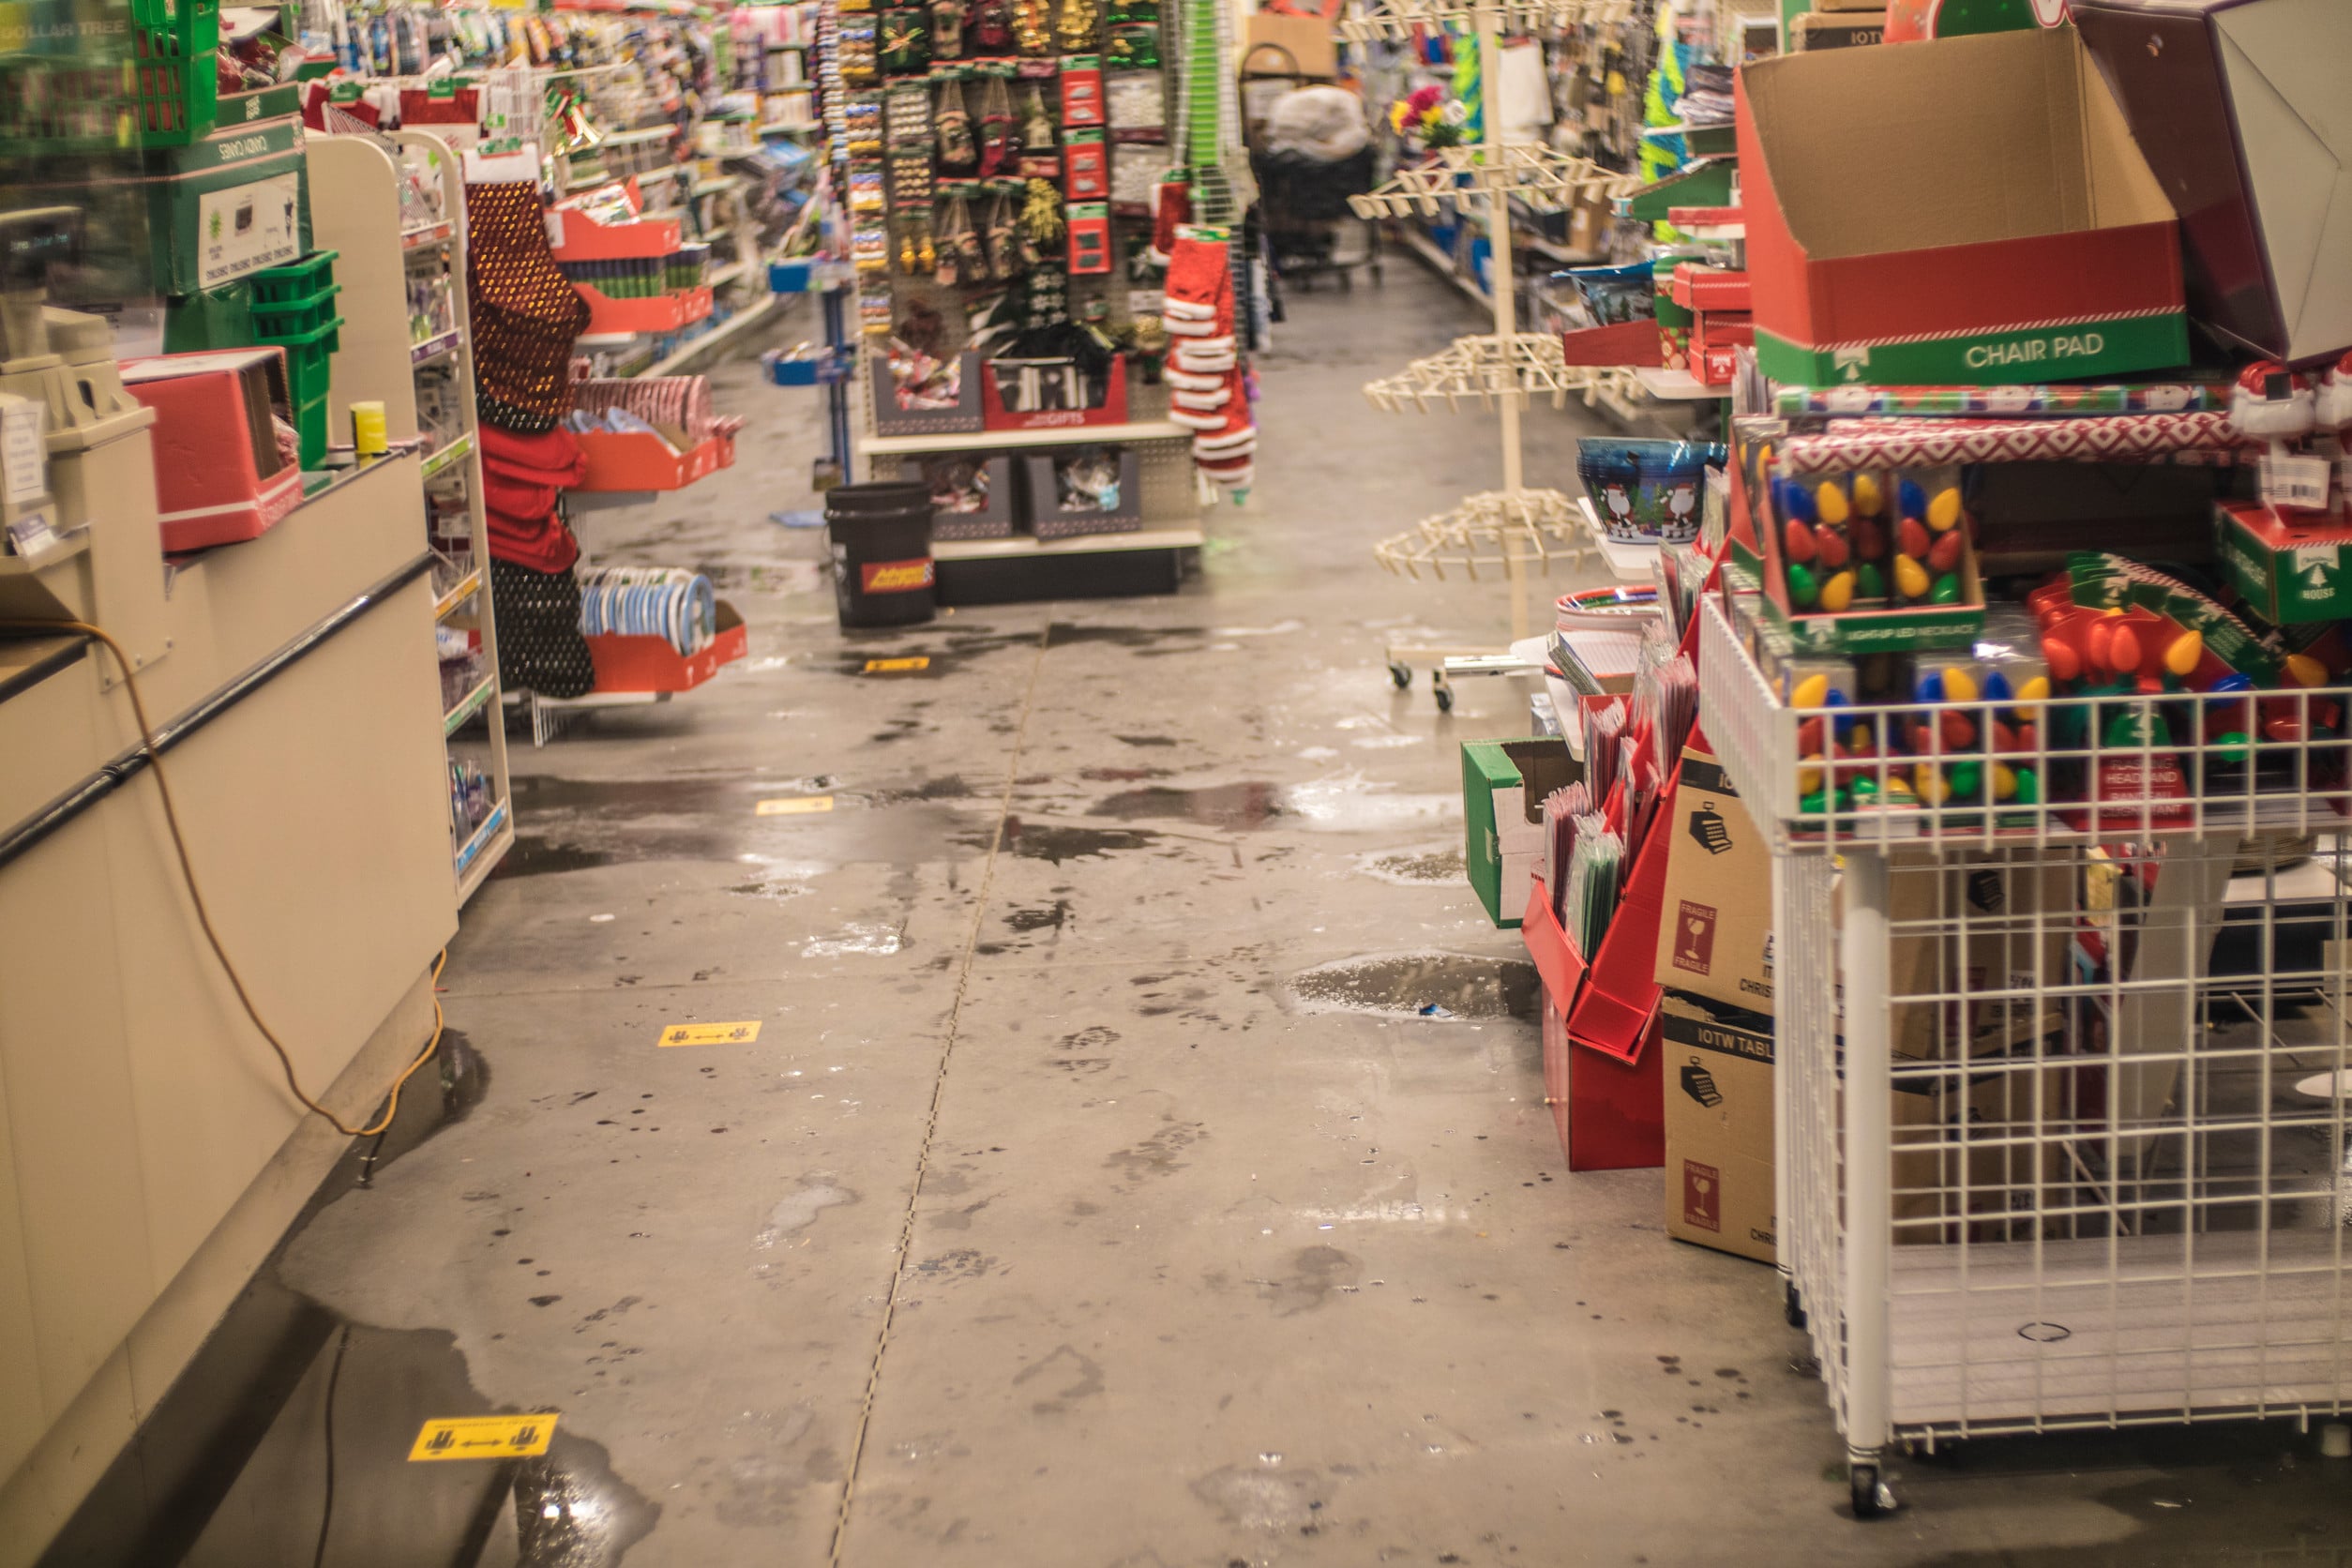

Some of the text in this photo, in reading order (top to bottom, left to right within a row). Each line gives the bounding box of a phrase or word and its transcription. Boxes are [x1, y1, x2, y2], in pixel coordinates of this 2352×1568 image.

[79, 20, 127, 36] TREE
[219, 135, 267, 159] CANDY CANES
[1966, 333, 2104, 369] CHAIR PAD
[2302, 587, 2336, 600] HOUSE
[1895, 627, 1916, 639] LED
[1917, 624, 1976, 637] NECKLACE
[2110, 757, 2174, 770] FLASING
[2105, 771, 2178, 784] HEADAND
[1681, 903, 1715, 920] FRAGILE
[1674, 956, 1709, 973] FRAGILE
[1698, 1027, 1735, 1049] IOTW
[1686, 1162, 1719, 1180] FRAGILE
[1686, 1212, 1719, 1230] FRAGILE
